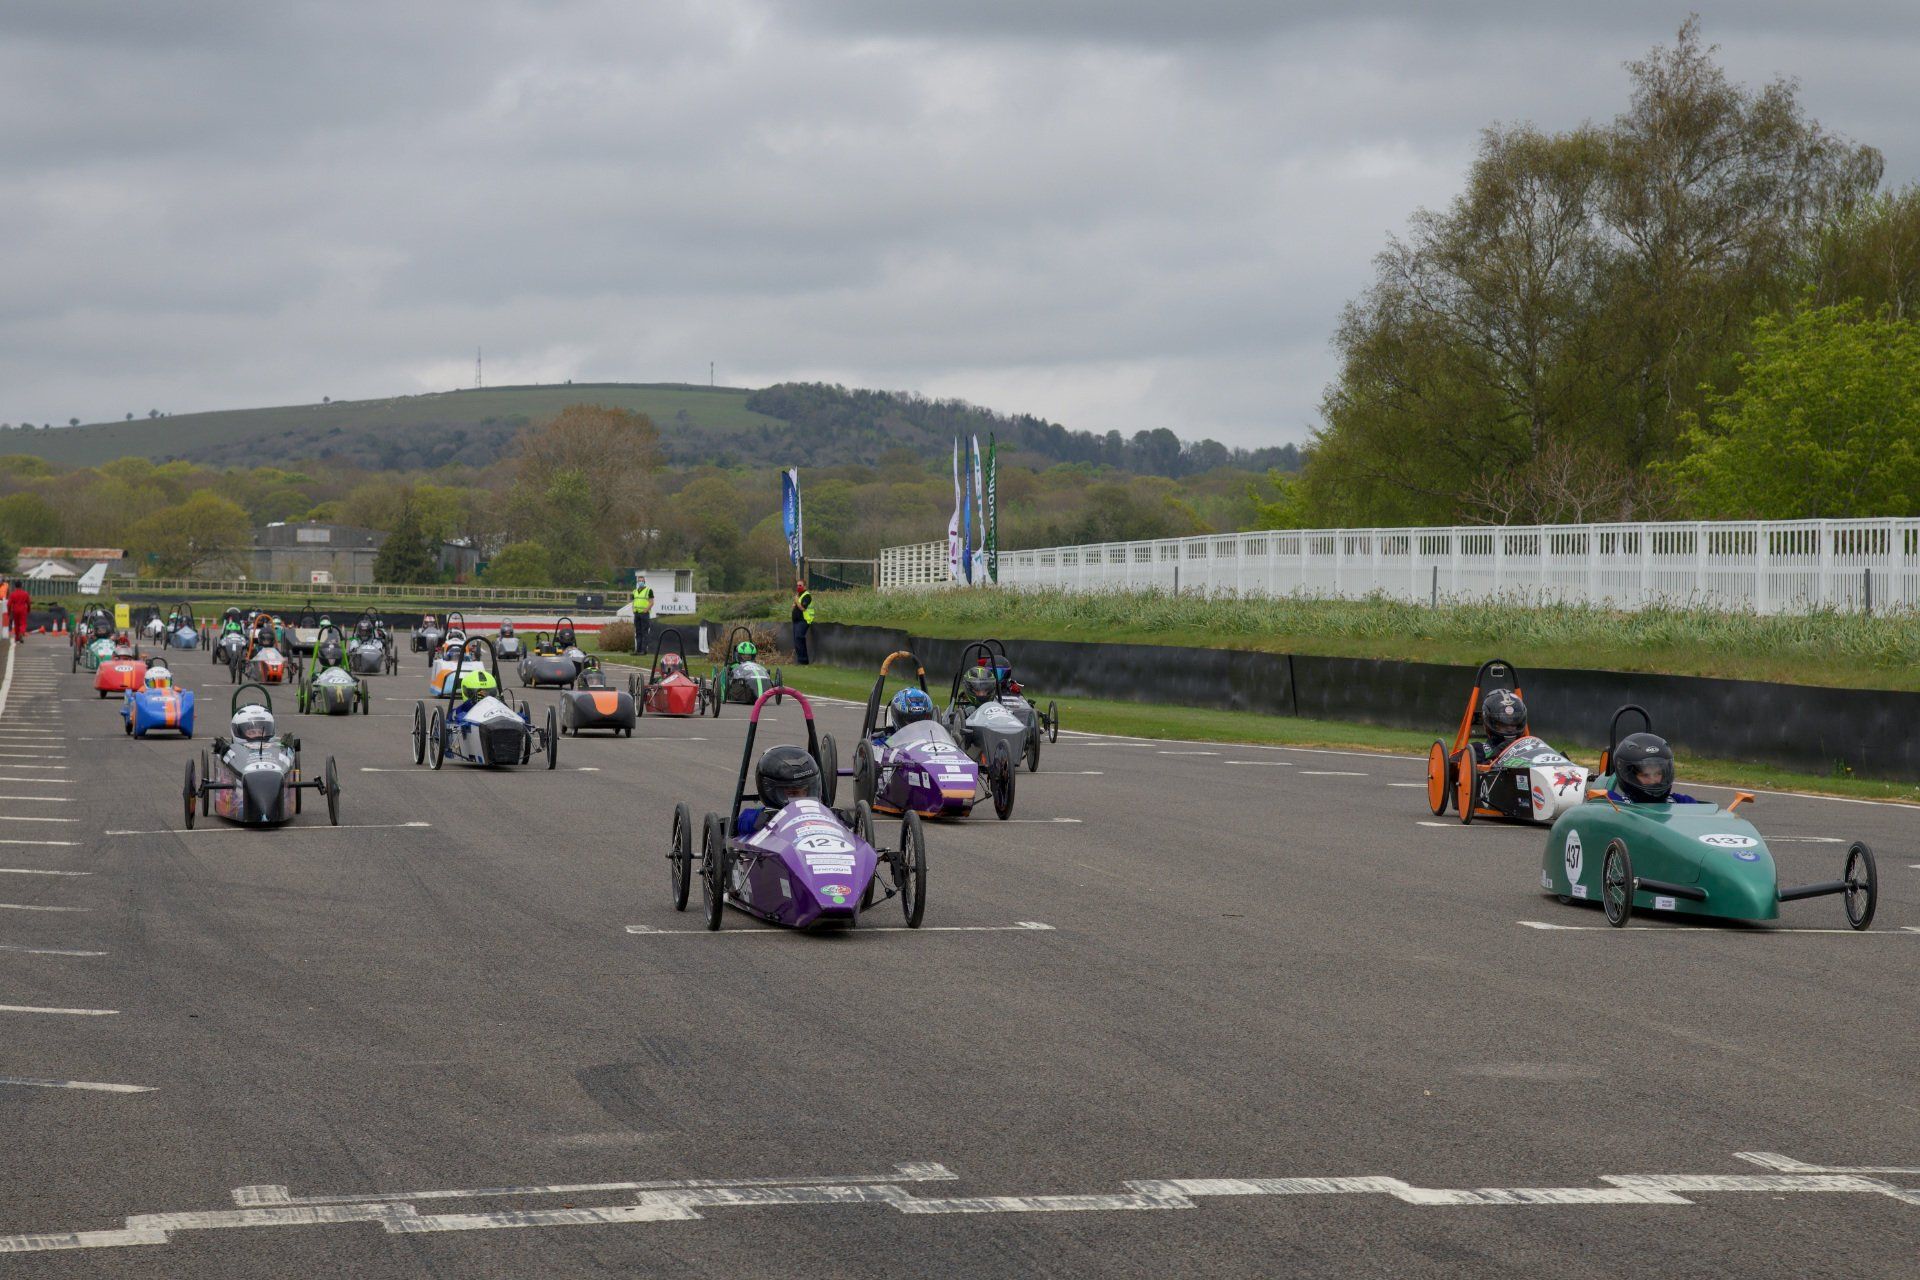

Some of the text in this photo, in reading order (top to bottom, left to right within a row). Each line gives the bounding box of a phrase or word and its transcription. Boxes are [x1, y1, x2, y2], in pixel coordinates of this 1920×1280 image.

[661, 604, 690, 612] ROLEX
[1540, 755, 1562, 763] 30
[804, 838, 846, 849] 127
[1705, 837, 1749, 845] 437
[1566, 844, 1581, 869] 437
